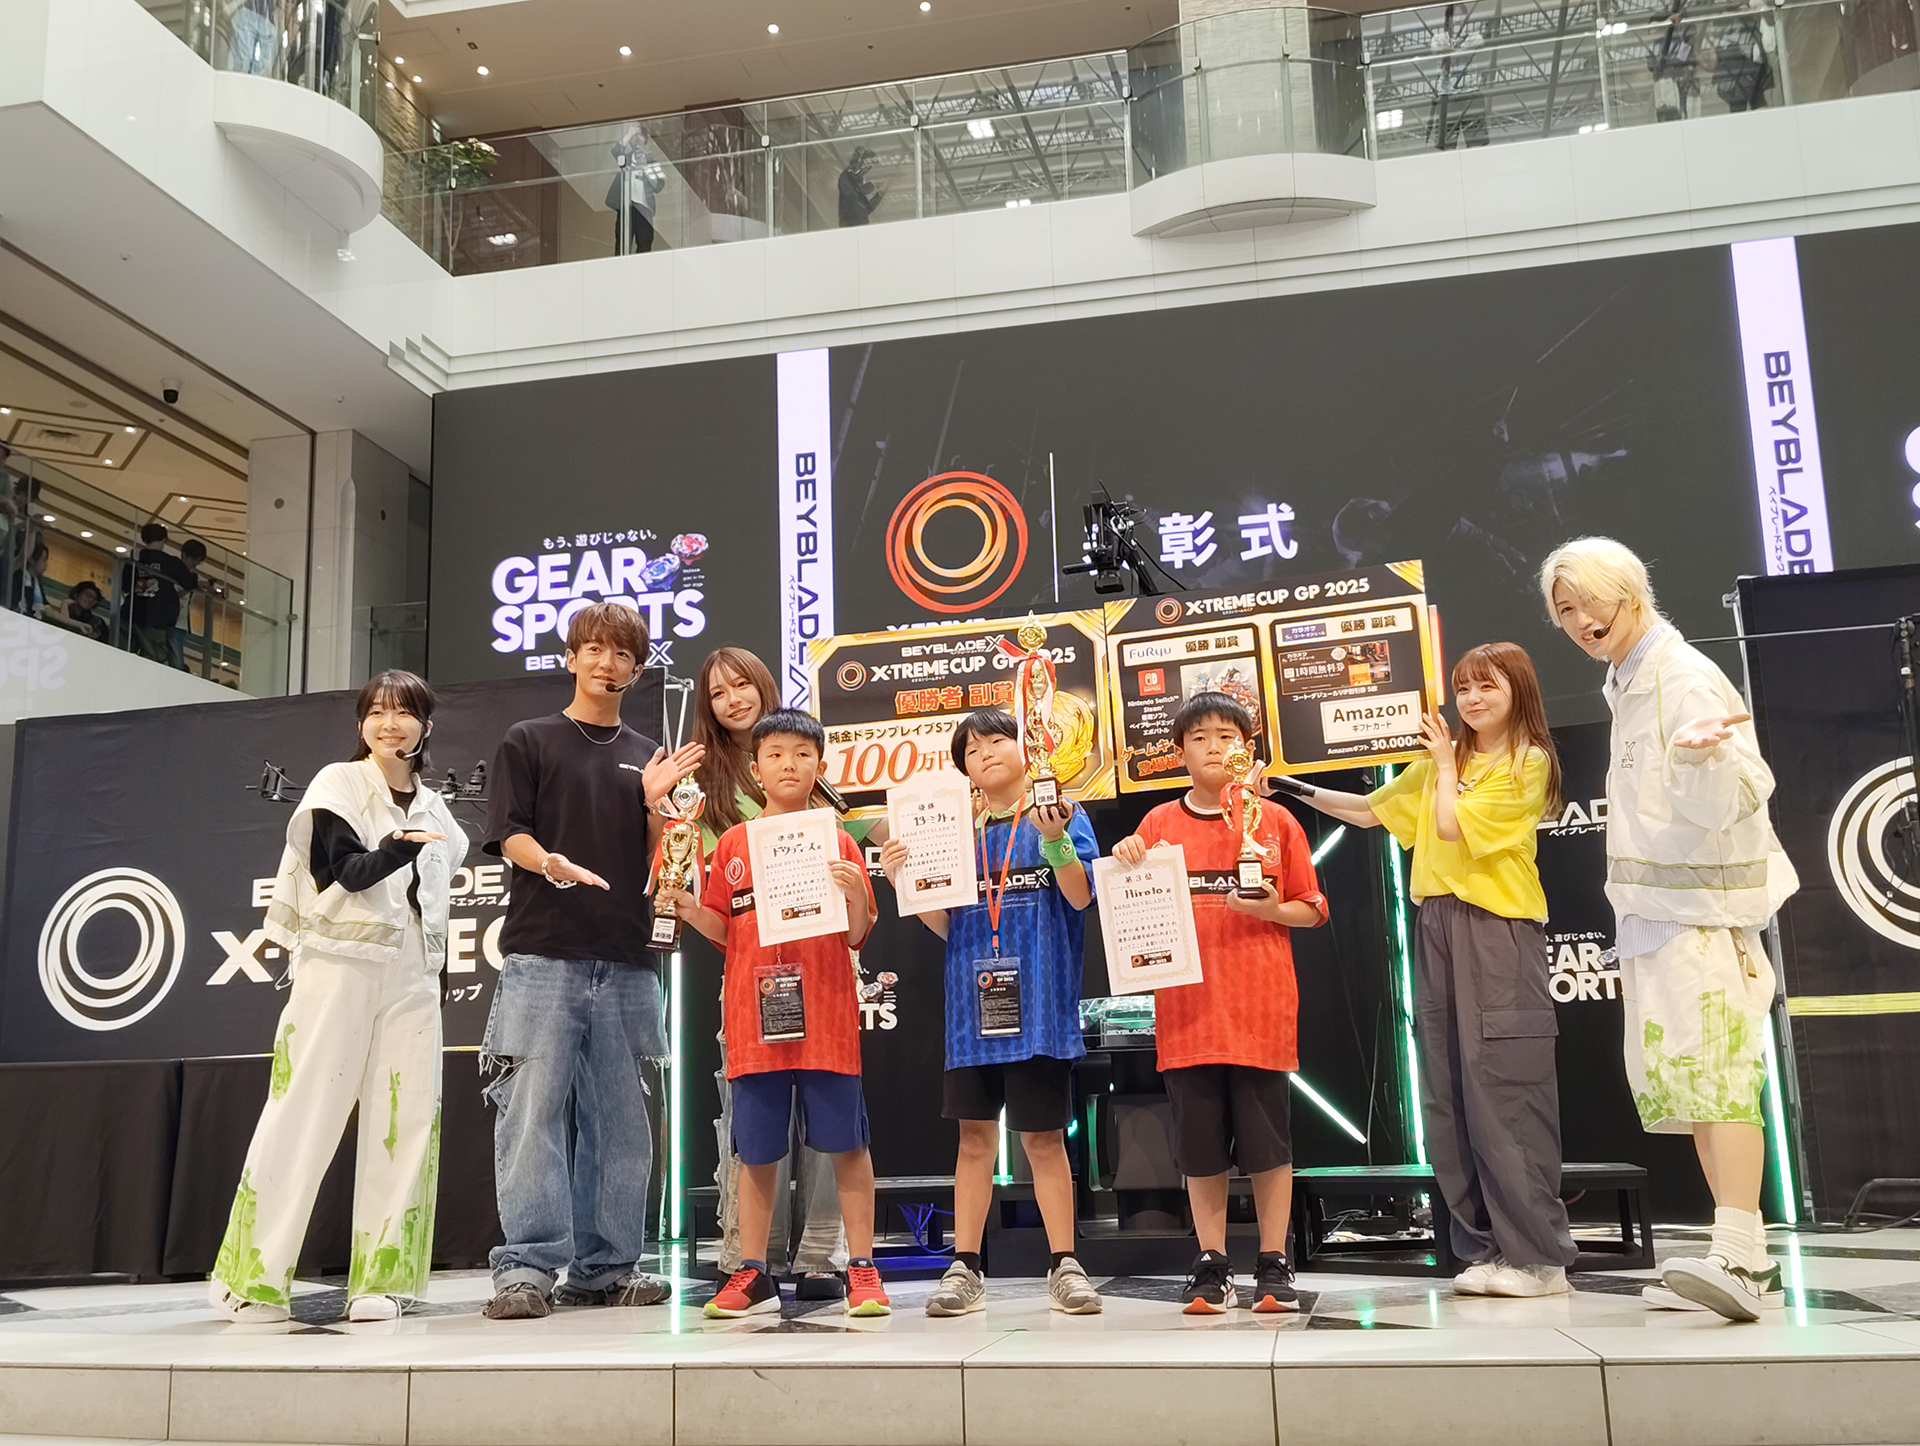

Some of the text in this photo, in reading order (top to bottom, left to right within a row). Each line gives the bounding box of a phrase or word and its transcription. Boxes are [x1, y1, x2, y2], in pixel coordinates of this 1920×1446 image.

[542, 528, 658, 550] もう、遊びじゃない。
[1768, 485, 1786, 575] ベイブレードエック
[491, 546, 648, 605] GEAR
[1294, 584, 1320, 601] GP
[1324, 577, 1370, 598] 2025
[1129, 646, 1172, 659] FuRyu
[895, 681, 1015, 714] 優勝者 副賞
[1333, 703, 1409, 723] Amazon
[1352, 721, 1392, 733] ギフトカード
[1549, 824, 1607, 837] ベイブレード
[1545, 931, 1607, 943] 、遊びじゃない。
